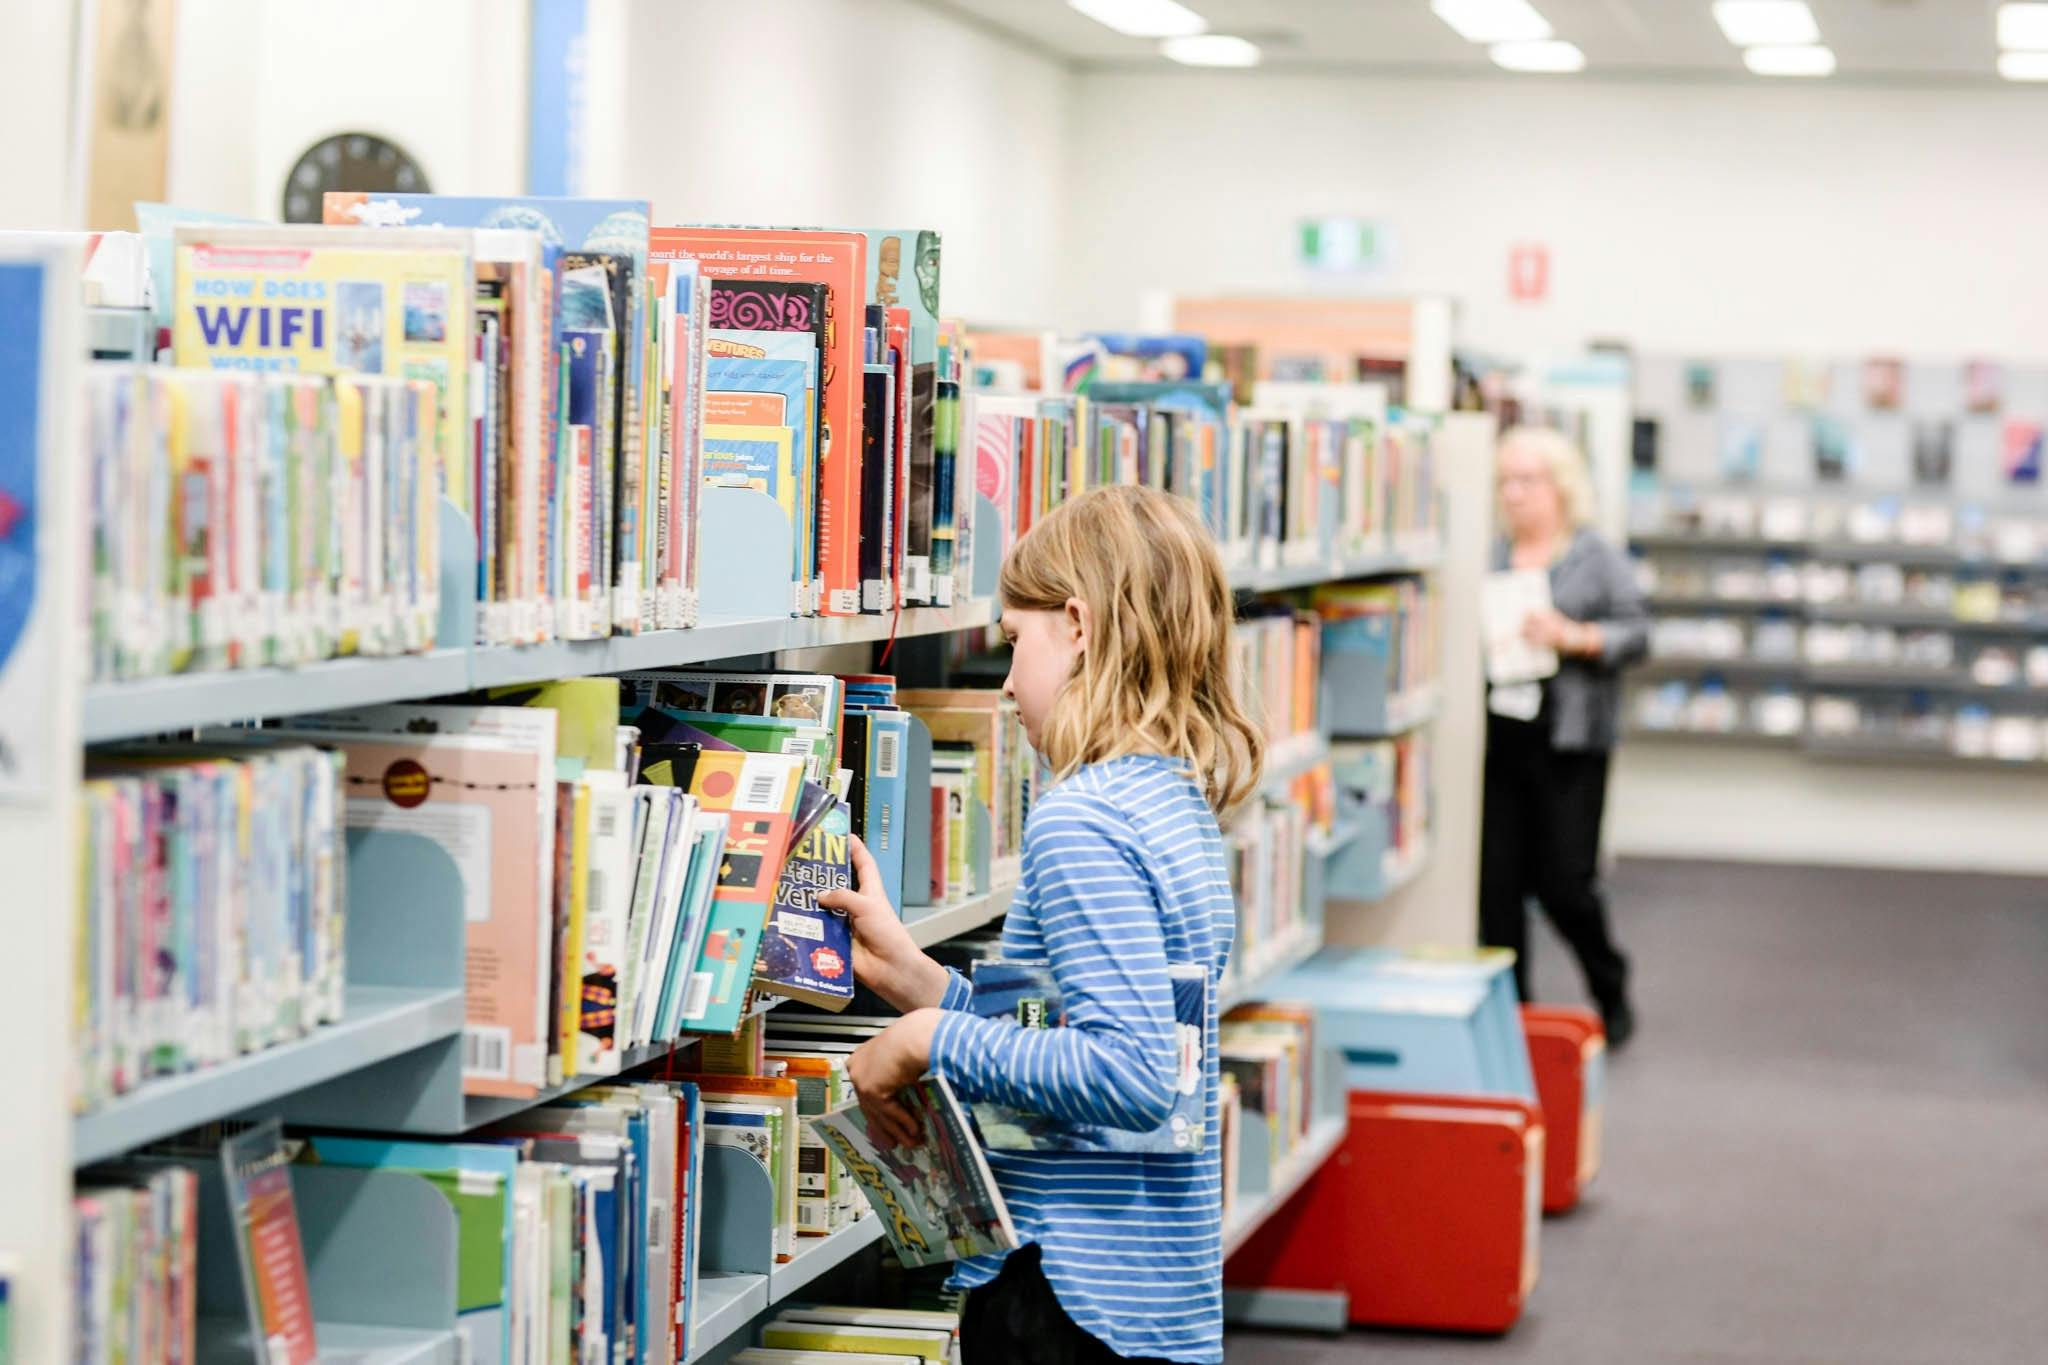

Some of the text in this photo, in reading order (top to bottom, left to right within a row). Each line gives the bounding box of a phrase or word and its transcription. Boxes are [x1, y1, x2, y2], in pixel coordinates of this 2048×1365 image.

[679, 250, 695, 260] the
[698, 251, 733, 261] world's
[737, 252, 771, 263] largest
[775, 252, 796, 264] ship
[799, 252, 813, 263] for
[816, 253, 834, 263] the
[703, 266, 738, 276] voyage
[740, 265, 752, 274] of
[753, 265, 767, 275] all
[195, 279, 326, 298] HOW DOES
[194, 305, 324, 348] WIFI
